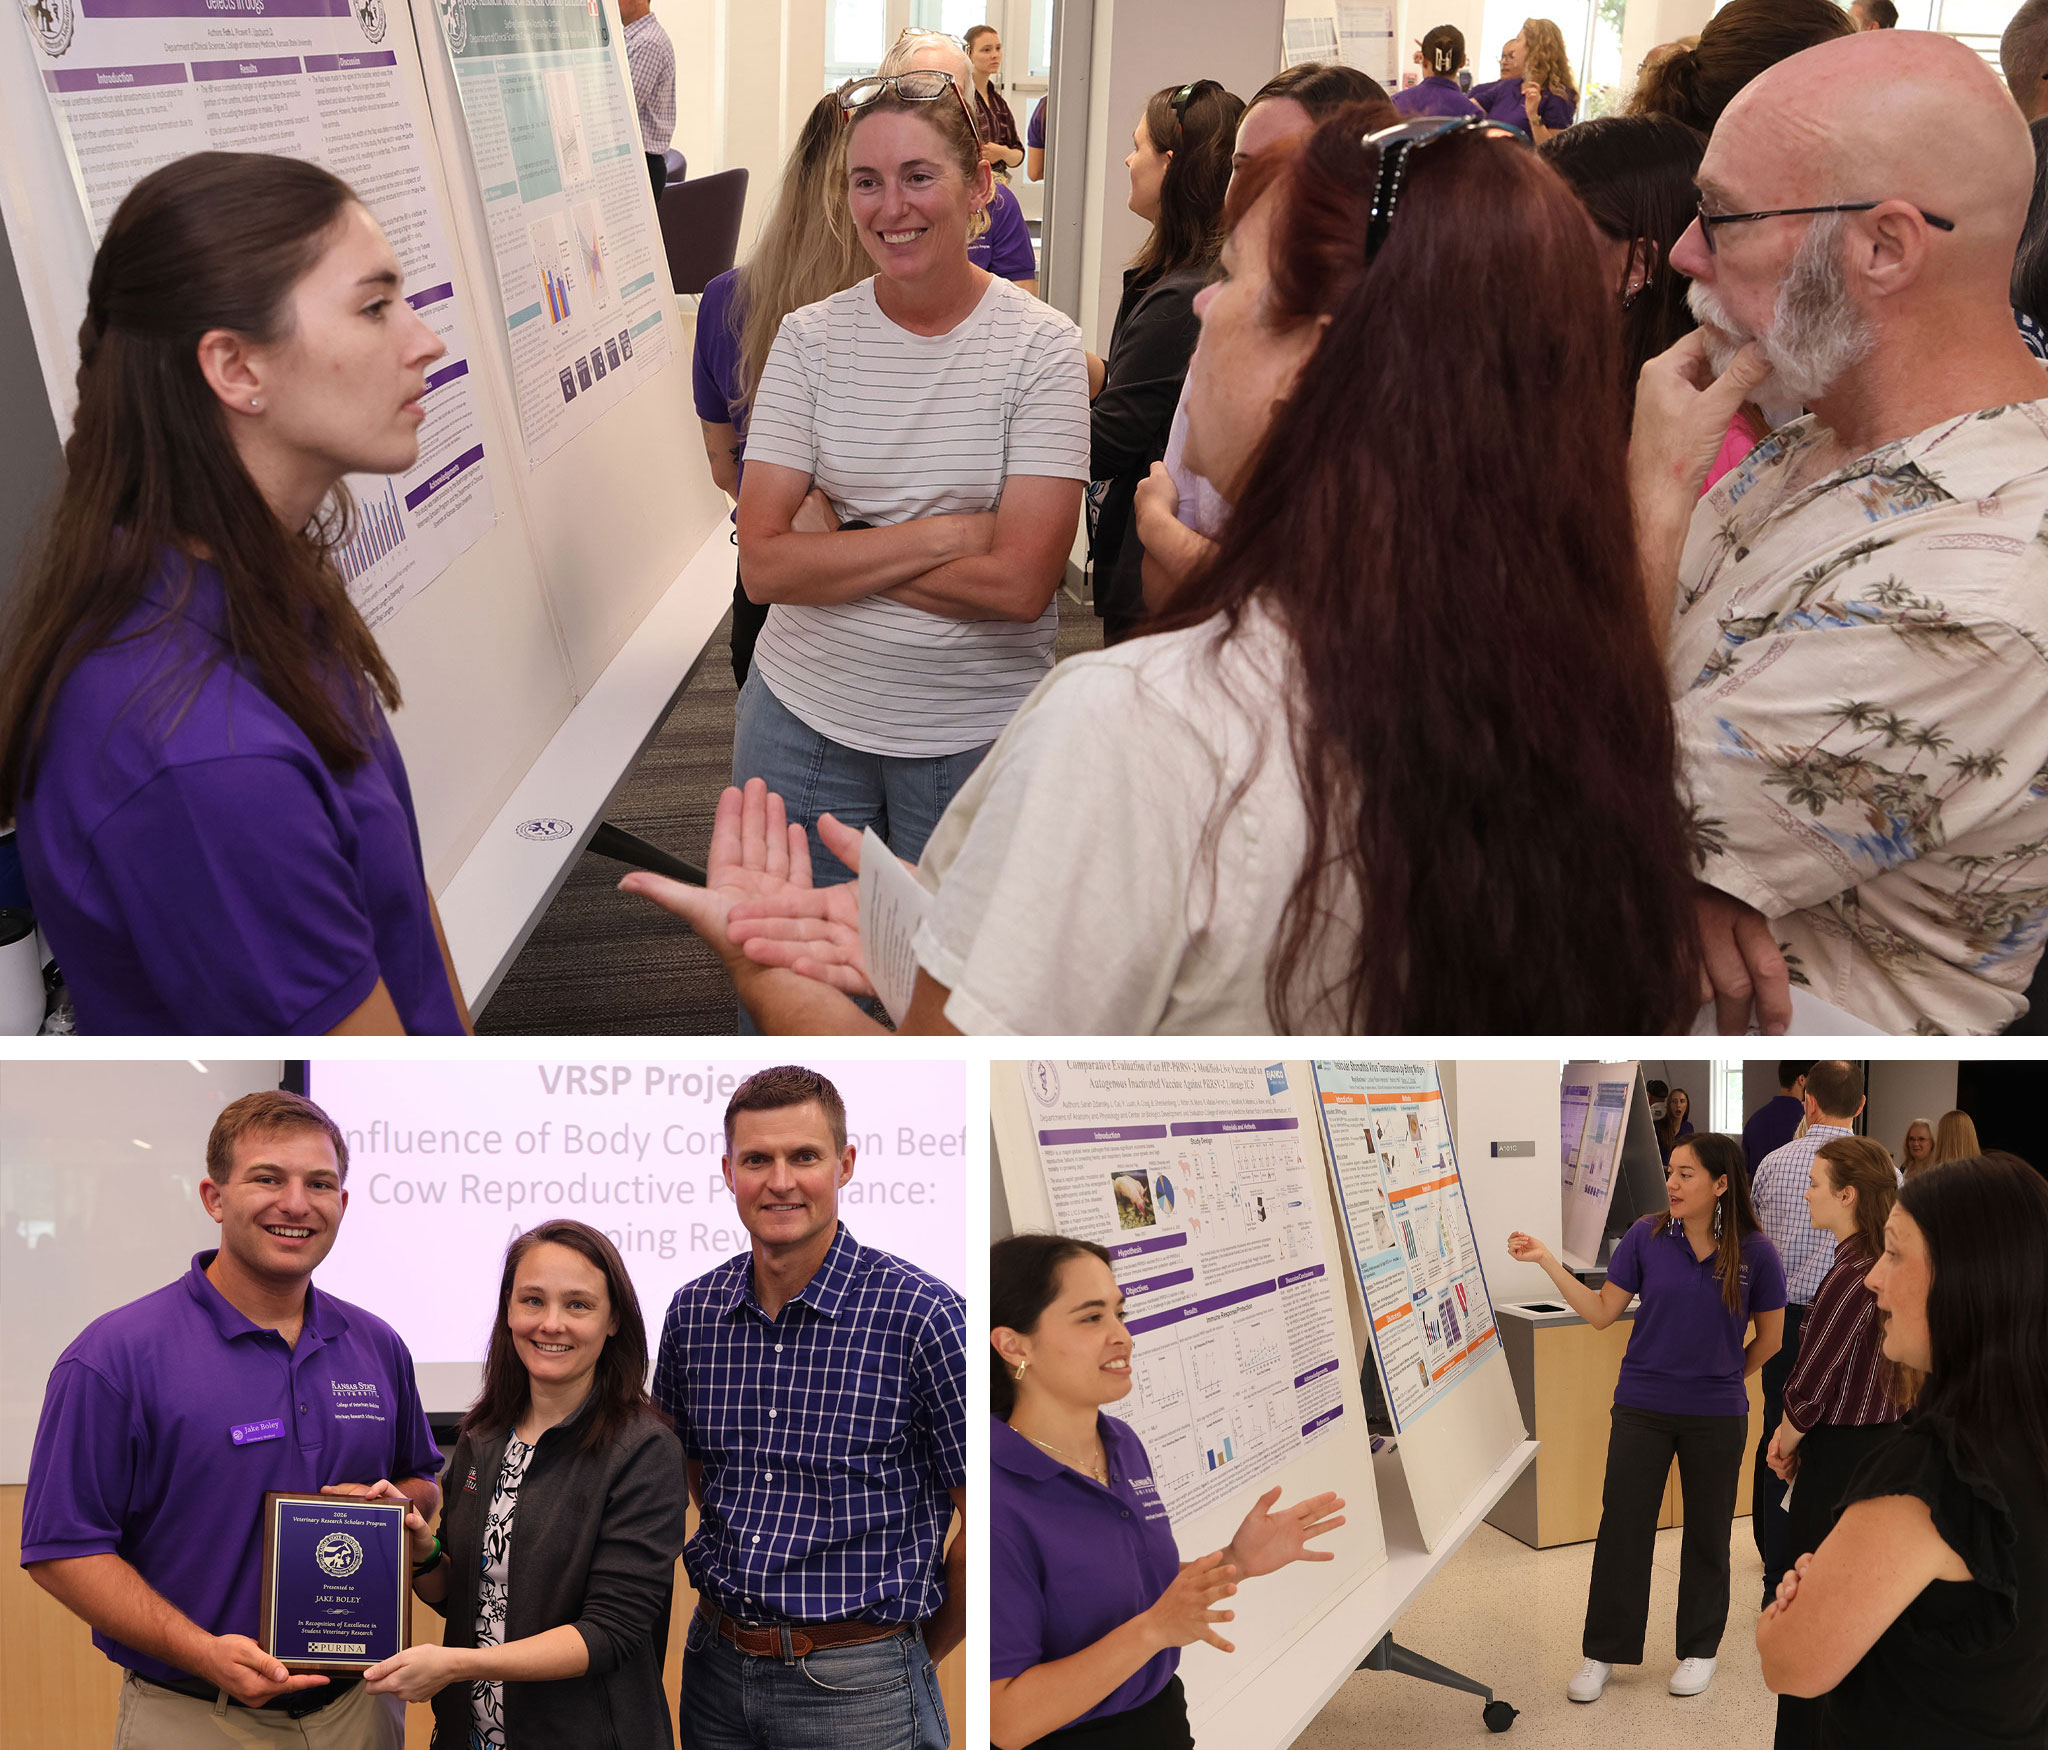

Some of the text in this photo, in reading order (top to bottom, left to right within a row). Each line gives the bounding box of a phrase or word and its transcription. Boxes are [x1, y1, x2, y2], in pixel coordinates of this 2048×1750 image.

[339, 56, 361, 67] Discussion
[239, 63, 258, 74] Results
[96, 71, 134, 84] Introduction
[1066, 1060, 1110, 1073] Comparative
[1111, 1060, 1145, 1072] Evaluation
[1145, 1061, 1152, 1072] of
[538, 1064, 749, 1104] VRSP Proje
[1089, 1077, 1127, 1091] Autogenous
[1128, 1077, 1160, 1089] Inactivated
[1160, 1078, 1183, 1089] Vaccine
[346, 1120, 502, 1154] nfluence
[515, 1121, 552, 1155] of
[564, 1122, 651, 1162] Body
[1094, 1131, 1121, 1140] Introduction
[1190, 1137, 1213, 1146] Study Design
[369, 1173, 447, 1204] Cow
[461, 1172, 695, 1212] Reproductive
[1117, 1245, 1143, 1257] Hypothesis
[1125, 1284, 1149, 1296] Objectives
[1183, 1306, 1198, 1317] Results
[244, 1421, 279, 1435] Jake Boley
[293, 1516, 320, 1525] Veterinary
[366, 1520, 387, 1528] Program
[314, 1595, 361, 1604] JAKE BOLEY
[305, 1620, 336, 1628] Recognition
[336, 1621, 344, 1629] of
[343, 1621, 370, 1629] Excellence
[322, 1629, 350, 1637] Veterinary
[320, 1643, 363, 1653] PURINA
